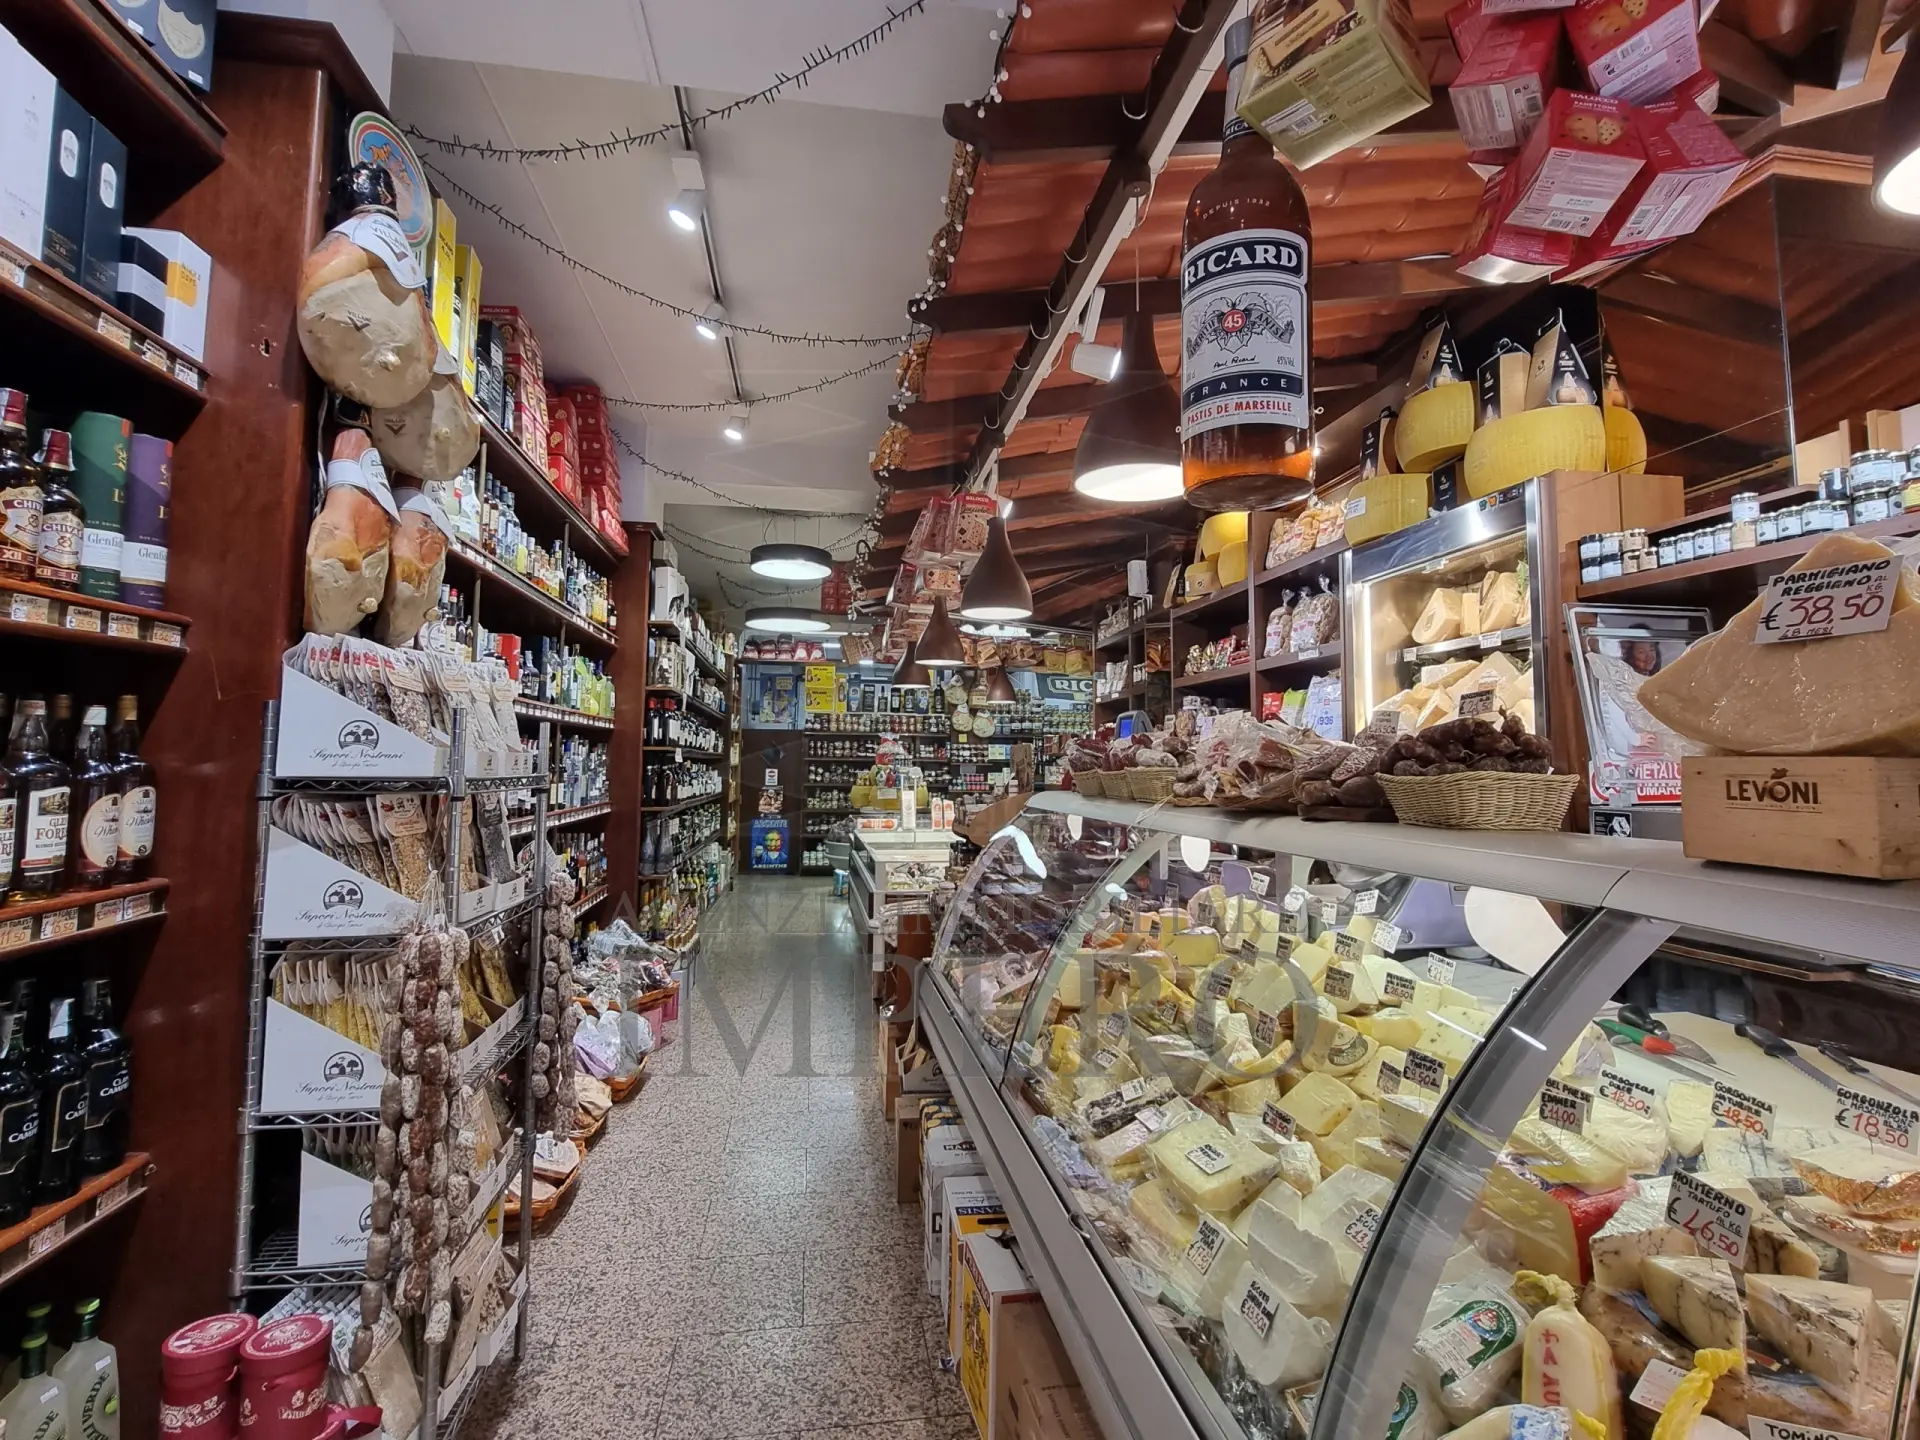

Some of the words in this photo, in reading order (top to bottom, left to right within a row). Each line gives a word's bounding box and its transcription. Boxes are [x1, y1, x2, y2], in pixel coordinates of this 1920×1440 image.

[1570, 93, 1619, 104] BALOCCO
[1574, 101, 1617, 112] PANETTONE
[1203, 199, 1239, 219] DEPUIS
[1247, 198, 1270, 207] 1932
[1184, 244, 1298, 288] RICARD
[1224, 314, 1243, 329] 45
[1190, 377, 1288, 401] FRANCE
[1187, 408, 1213, 425] PASTIS
[1217, 403, 1229, 414] DE
[1234, 400, 1292, 412] MARSEILLE
[71, 572, 79, 581] 12
[1773, 560, 1890, 587] PARMIGIANO
[1781, 575, 1871, 597] REGGIANO
[1806, 626, 1834, 636] MESI
[309, 748, 347, 762] Sapori
[347, 748, 404, 760] Nostrani
[1637, 782, 1682, 796] UMARE
[294, 909, 336, 924] Sapori
[336, 908, 388, 921] Nostrani
[295, 1083, 336, 1097] Sapori
[1546, 1077, 1560, 1091] BEL
[1562, 1086, 1592, 1103] PAESE
[1714, 1081, 1773, 1114] GORGONZOLA
[1836, 1098, 1848, 1107] AL
[1850, 1101, 1914, 1129] MASCARPONE
[1837, 1087, 1920, 1122] GORGONZOLA
[1671, 1182, 1681, 1193] AL
[1687, 1190, 1731, 1219] TARTUFO
[1673, 1170, 1746, 1216] MOLITERNO
